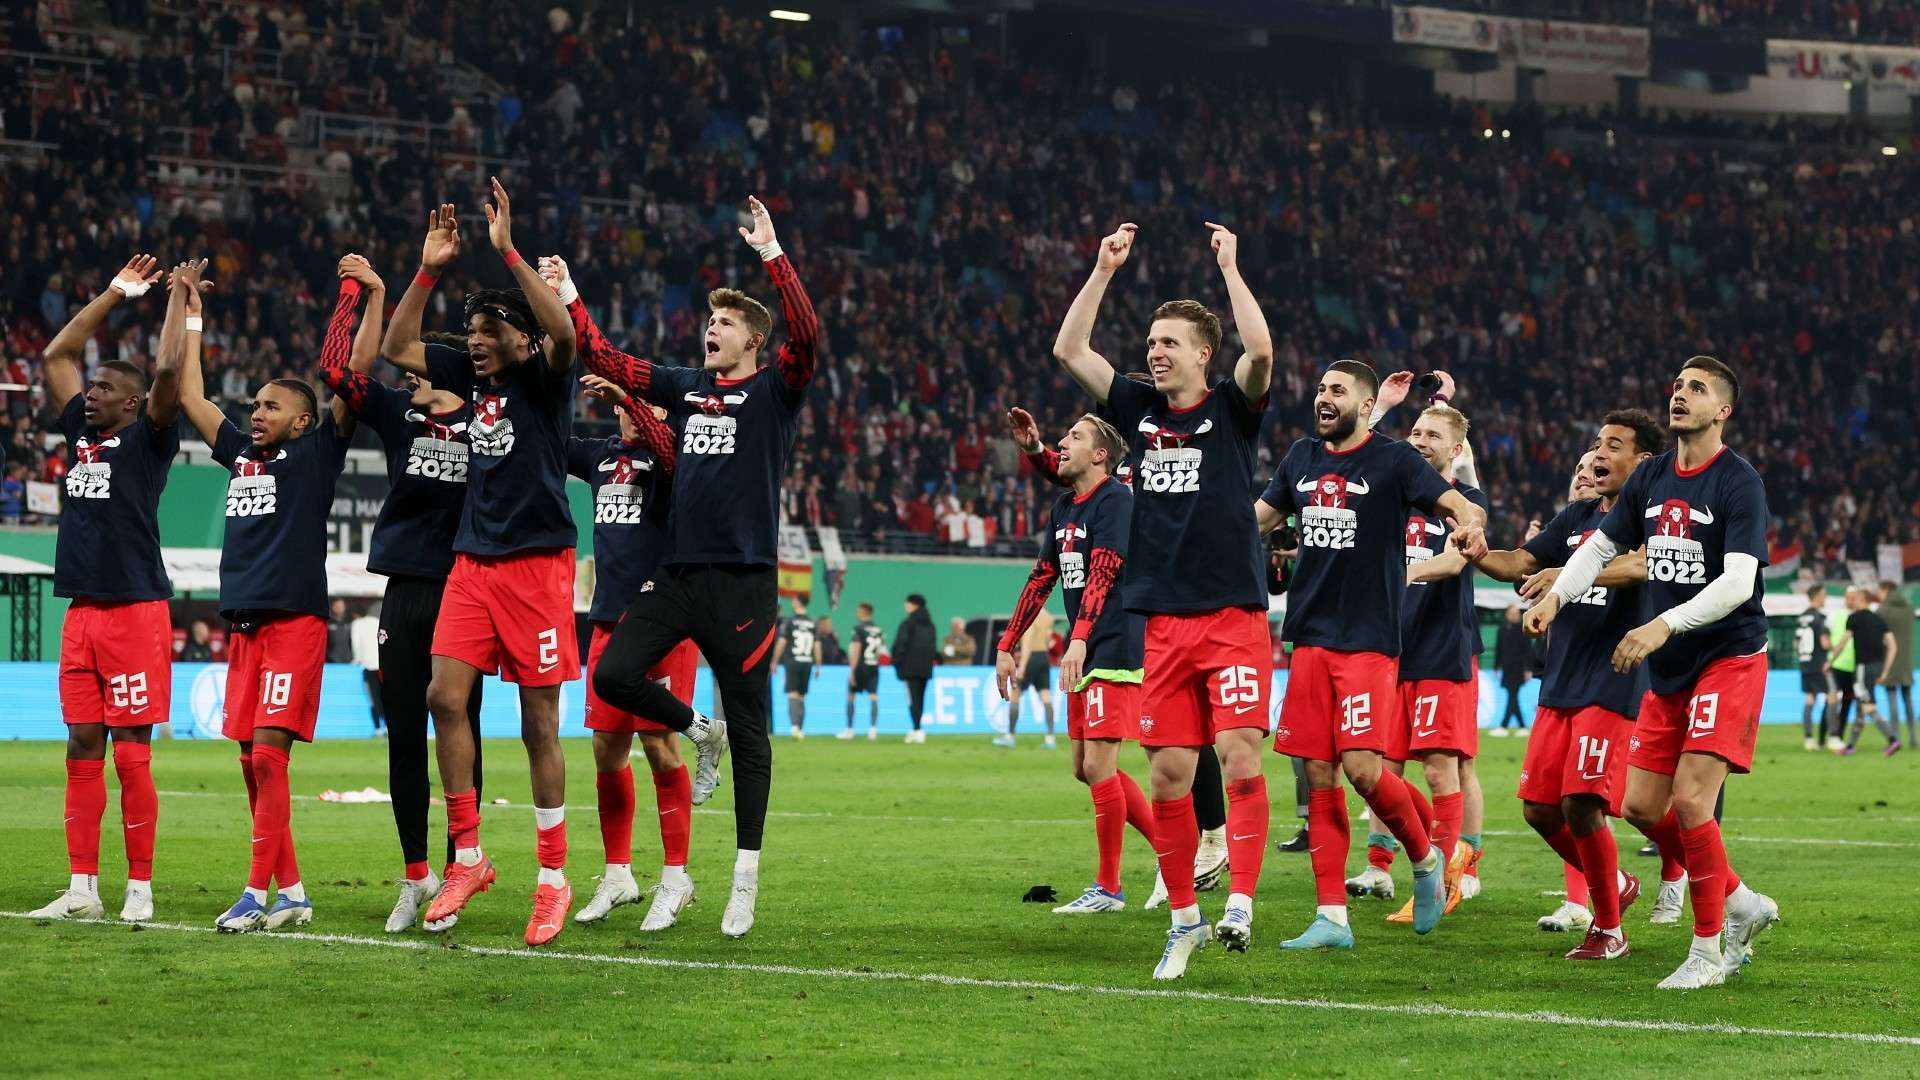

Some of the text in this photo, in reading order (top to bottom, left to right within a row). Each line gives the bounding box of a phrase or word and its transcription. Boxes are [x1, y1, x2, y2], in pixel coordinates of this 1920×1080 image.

[684, 425, 737, 437] FINALE BERLIN
[410, 448, 468, 463] FINALE BERLIN
[683, 433, 736, 455] 2022
[406, 456, 468, 483] 2022
[1140, 460, 1201, 472] FINALE BERLIN
[1140, 469, 1200, 493] 2022
[226, 495, 276, 517] 2022
[595, 504, 641, 524] 2022
[1302, 517, 1357, 529] FINALE BERLIN
[1303, 526, 1356, 549] 2022
[1675, 551, 1705, 562] BERLIN
[1647, 558, 1707, 584] 2022
[1572, 587, 1607, 606] 22
[538, 628, 559, 665] 2
[111, 671, 148, 707] 22
[263, 671, 293, 706] 18
[1219, 665, 1260, 705] 25
[1341, 692, 1371, 732] 32
[1577, 735, 1609, 773] 14
